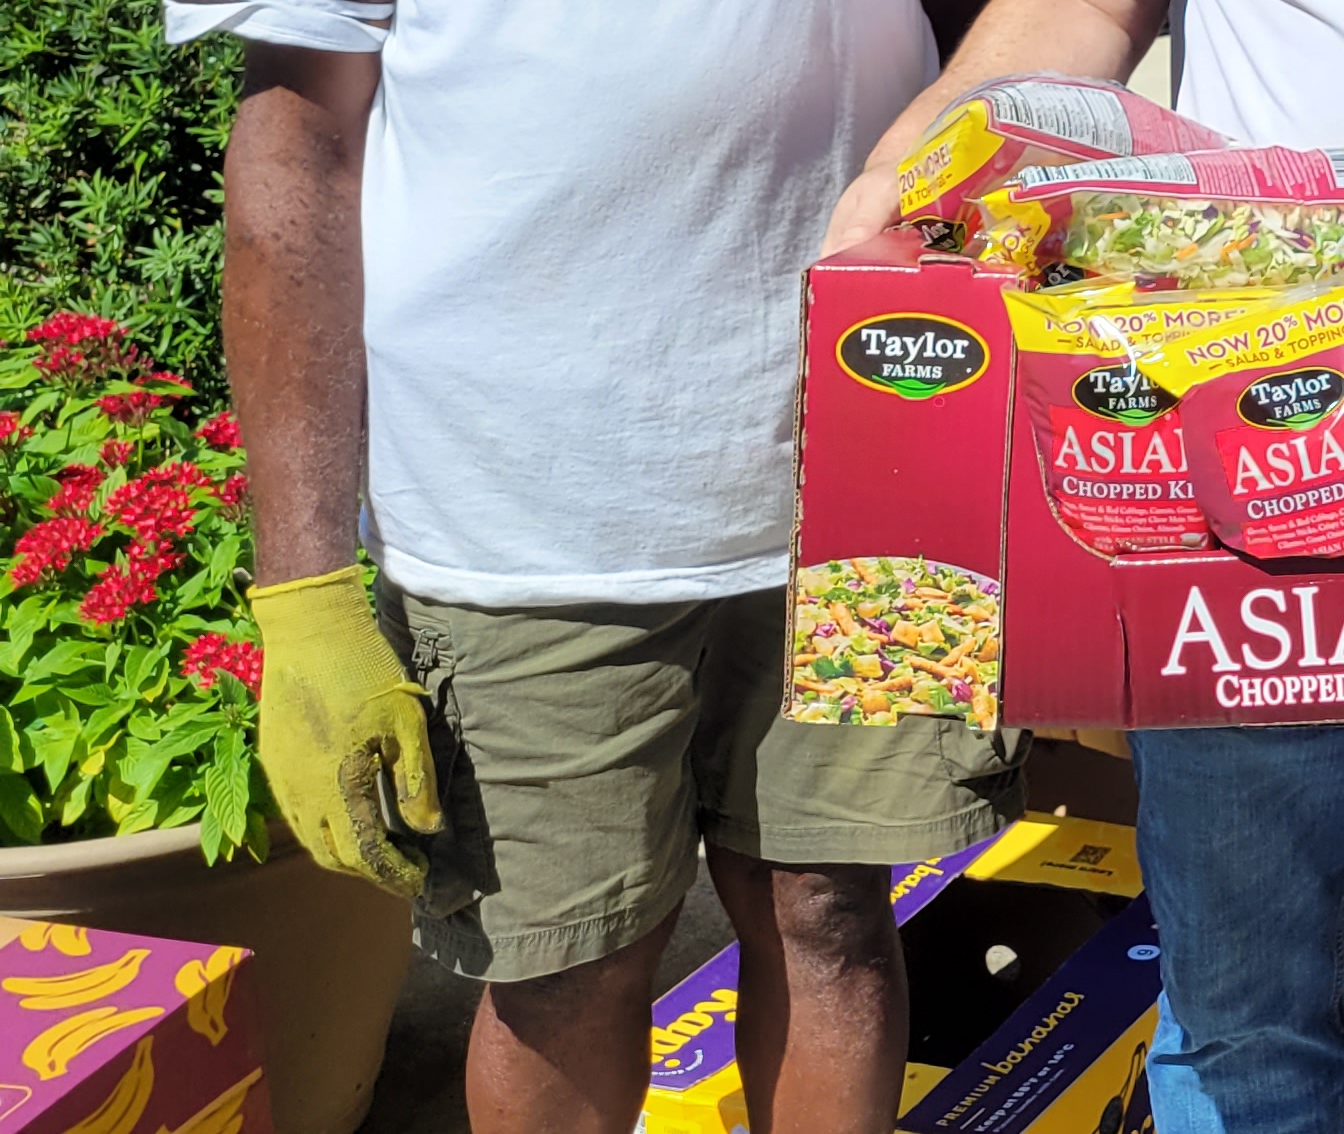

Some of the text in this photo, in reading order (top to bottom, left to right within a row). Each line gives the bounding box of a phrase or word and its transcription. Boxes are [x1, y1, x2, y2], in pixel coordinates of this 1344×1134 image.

[1118, 312, 1157, 334] 20%
[861, 328, 970, 365] Taylor
[1186, 333, 1252, 365] NOW
[1256, 315, 1299, 350] 20%
[1225, 351, 1270, 368] SALAD
[1274, 347, 1285, 359] &
[882, 363, 943, 379] FARMS
[1089, 371, 1160, 398] Tayl
[1251, 373, 1332, 406] Taylor
[1108, 395, 1158, 410] FARMS
[1274, 398, 1322, 419] FARMS
[1062, 476, 1195, 500] CHOPPED KI
[935, 991, 1085, 1127] PREMIUM bananas
